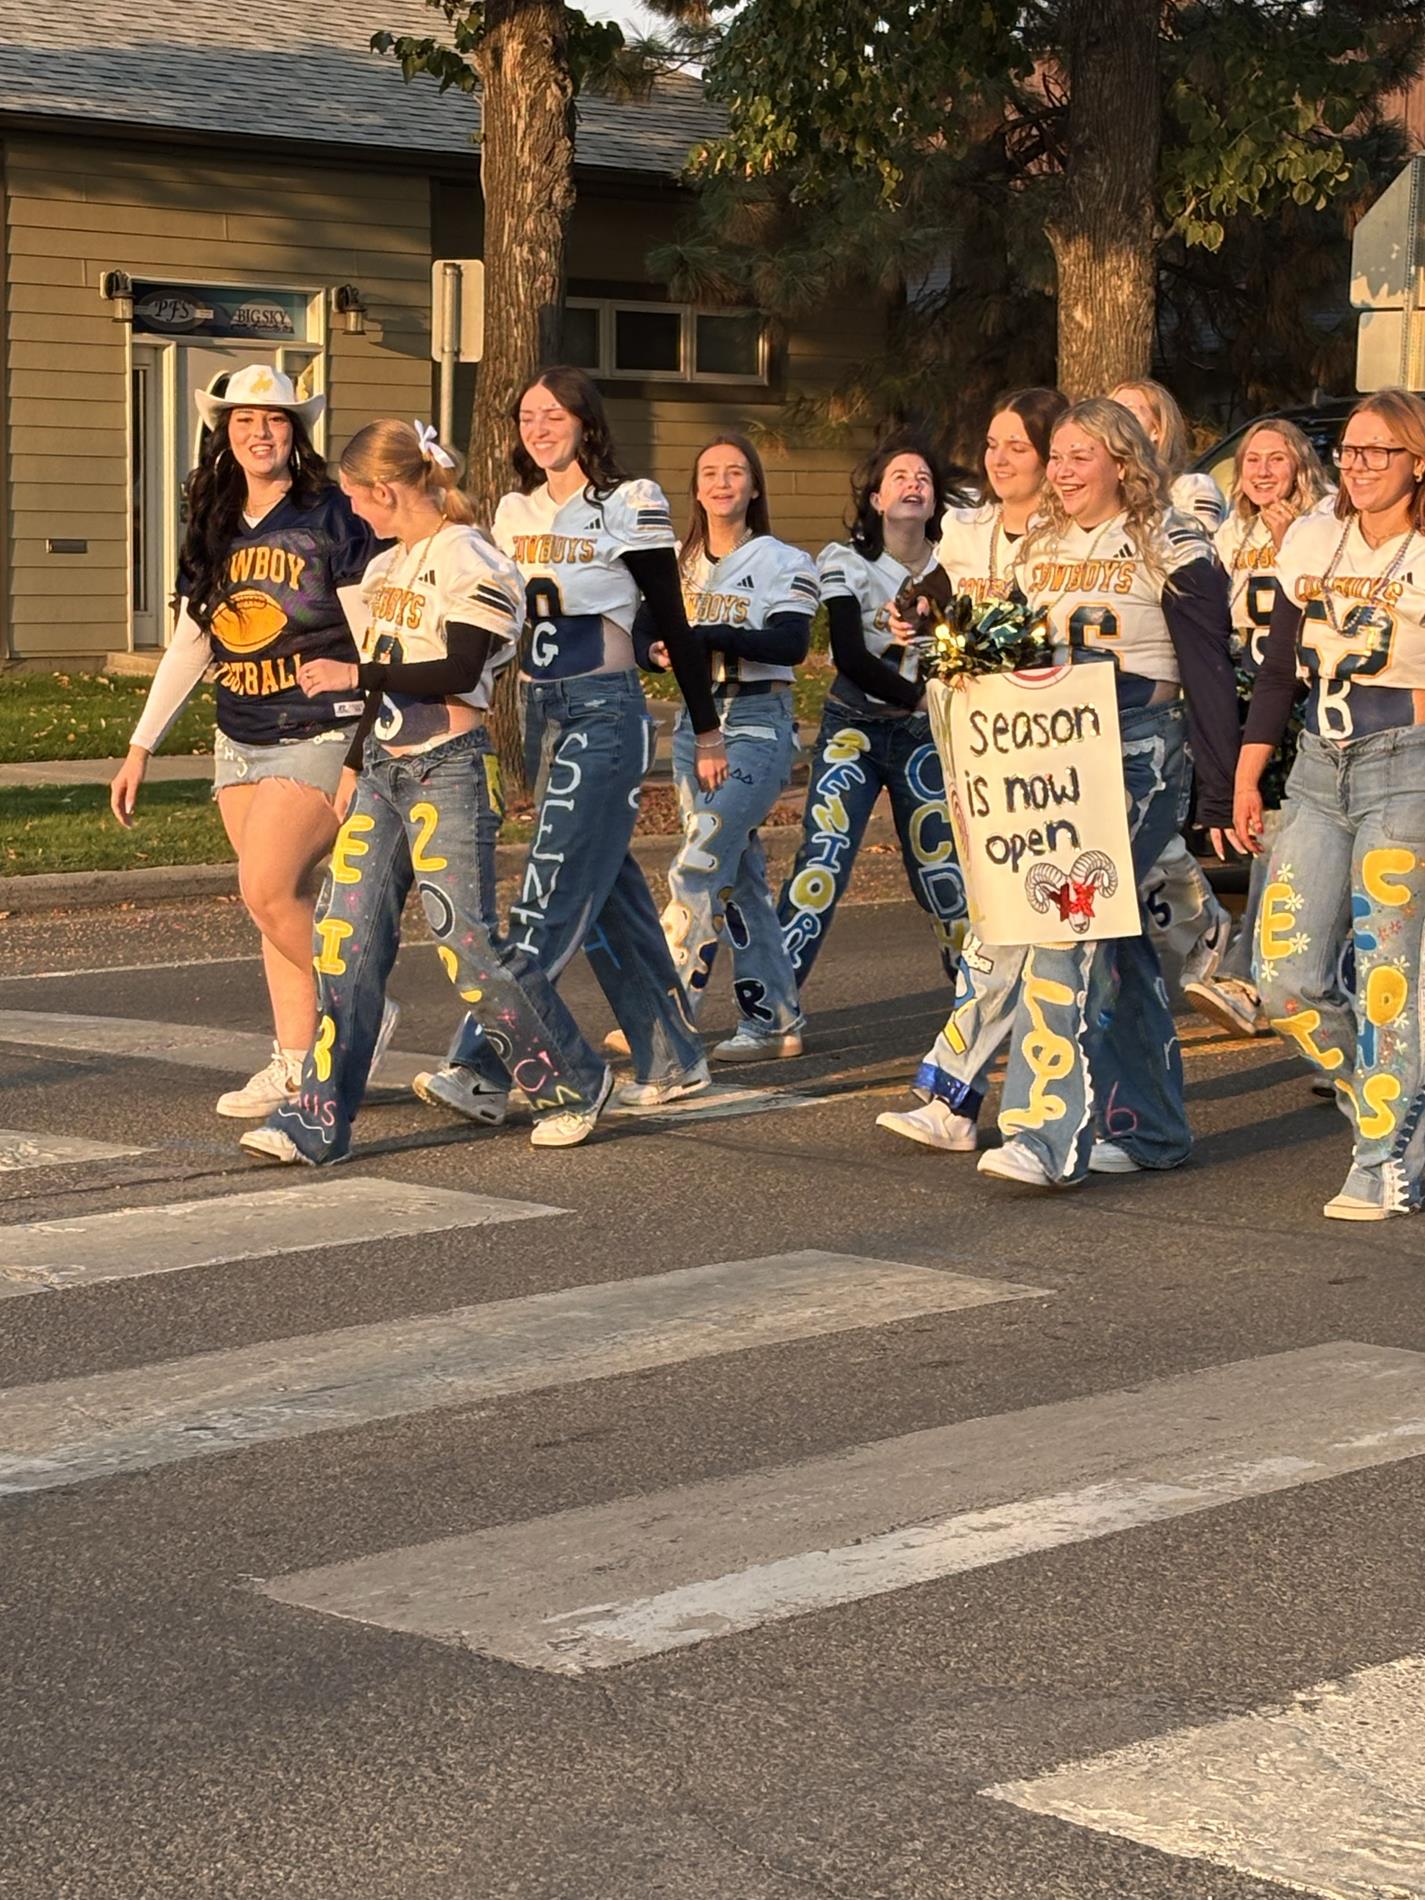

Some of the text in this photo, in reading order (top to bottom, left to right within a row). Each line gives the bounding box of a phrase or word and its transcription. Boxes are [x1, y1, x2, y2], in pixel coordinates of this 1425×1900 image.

[154, 299, 191, 322] PFS
[230, 547, 305, 590] WBOY
[512, 534, 597, 564] OWBOYS
[531, 621, 559, 667] G
[969, 702, 1101, 757] season
[964, 765, 1081, 818] is now
[782, 727, 872, 969] SENIOR
[985, 819, 1081, 873] open
